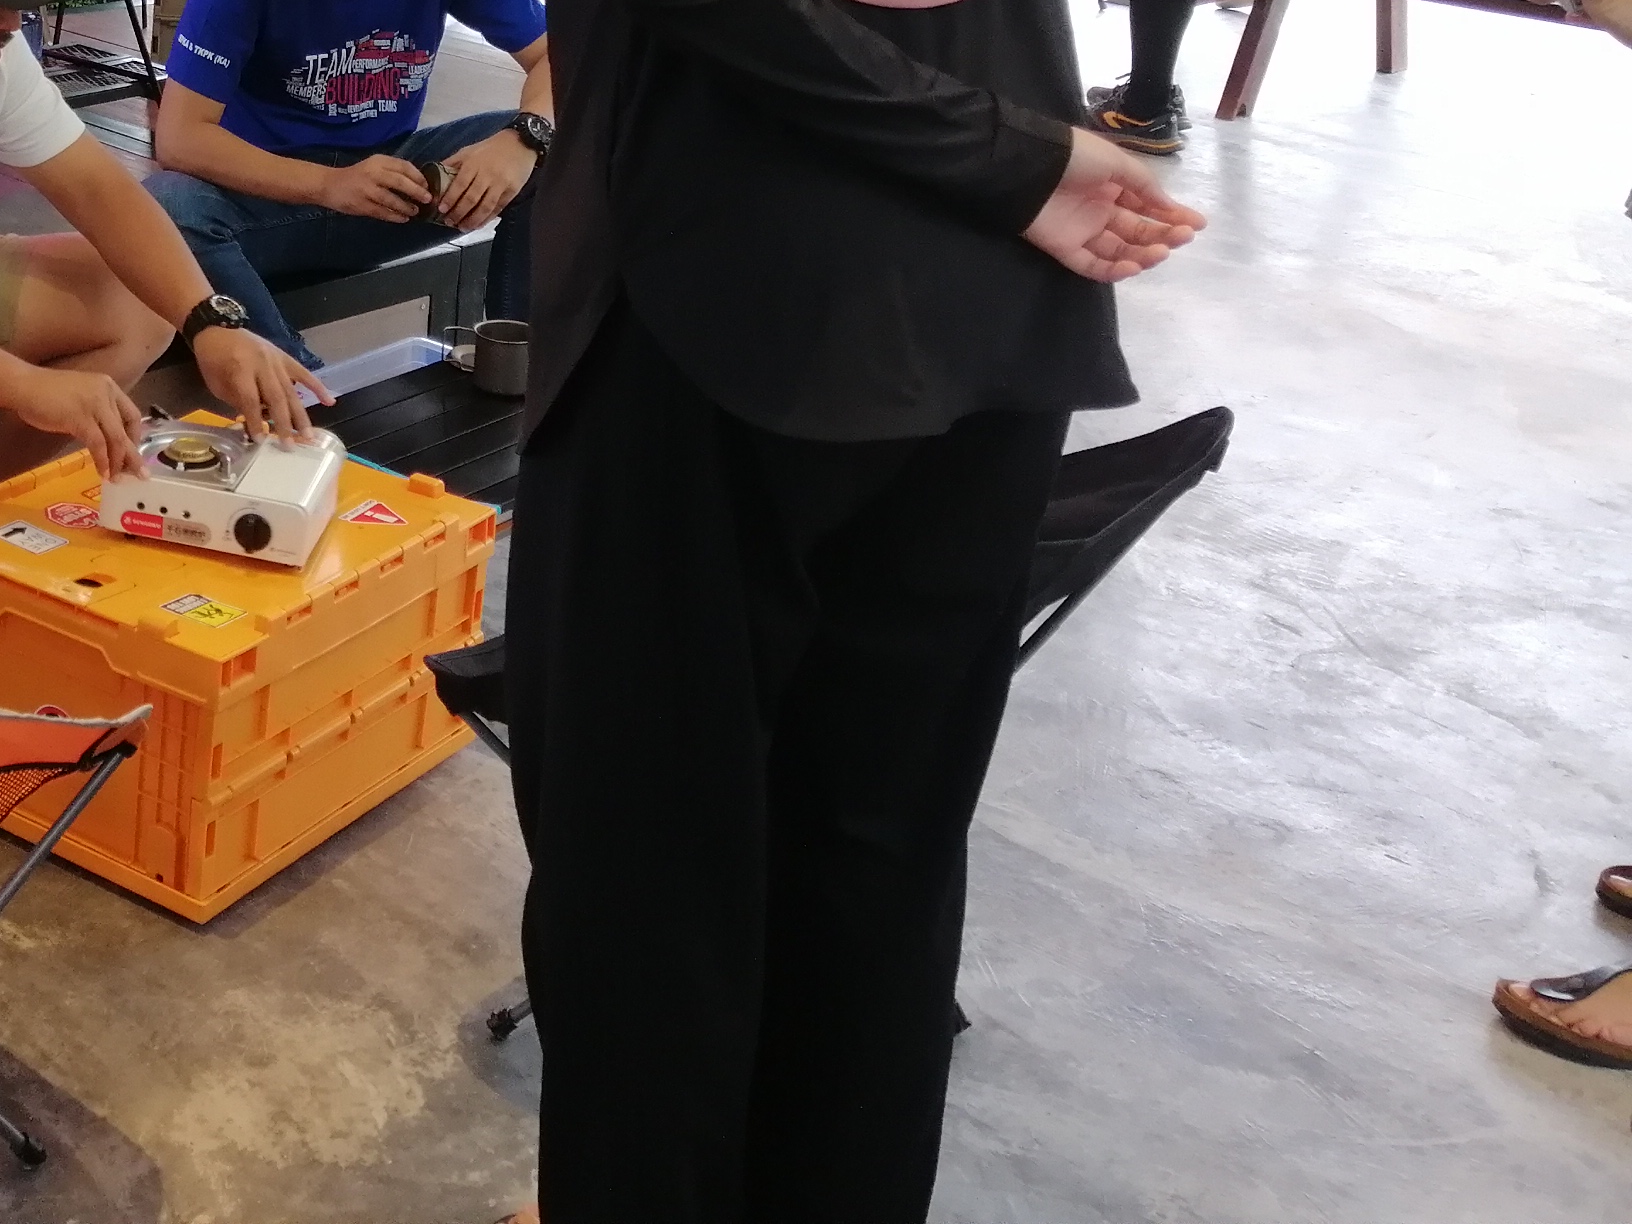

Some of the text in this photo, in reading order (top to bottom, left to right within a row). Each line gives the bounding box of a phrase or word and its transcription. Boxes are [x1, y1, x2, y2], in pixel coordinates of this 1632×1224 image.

[306, 46, 355, 85] TEAM
[286, 83, 327, 97] MEMBERS
[325, 67, 400, 104] BUILDING
[378, 100, 397, 112] TEAMS
